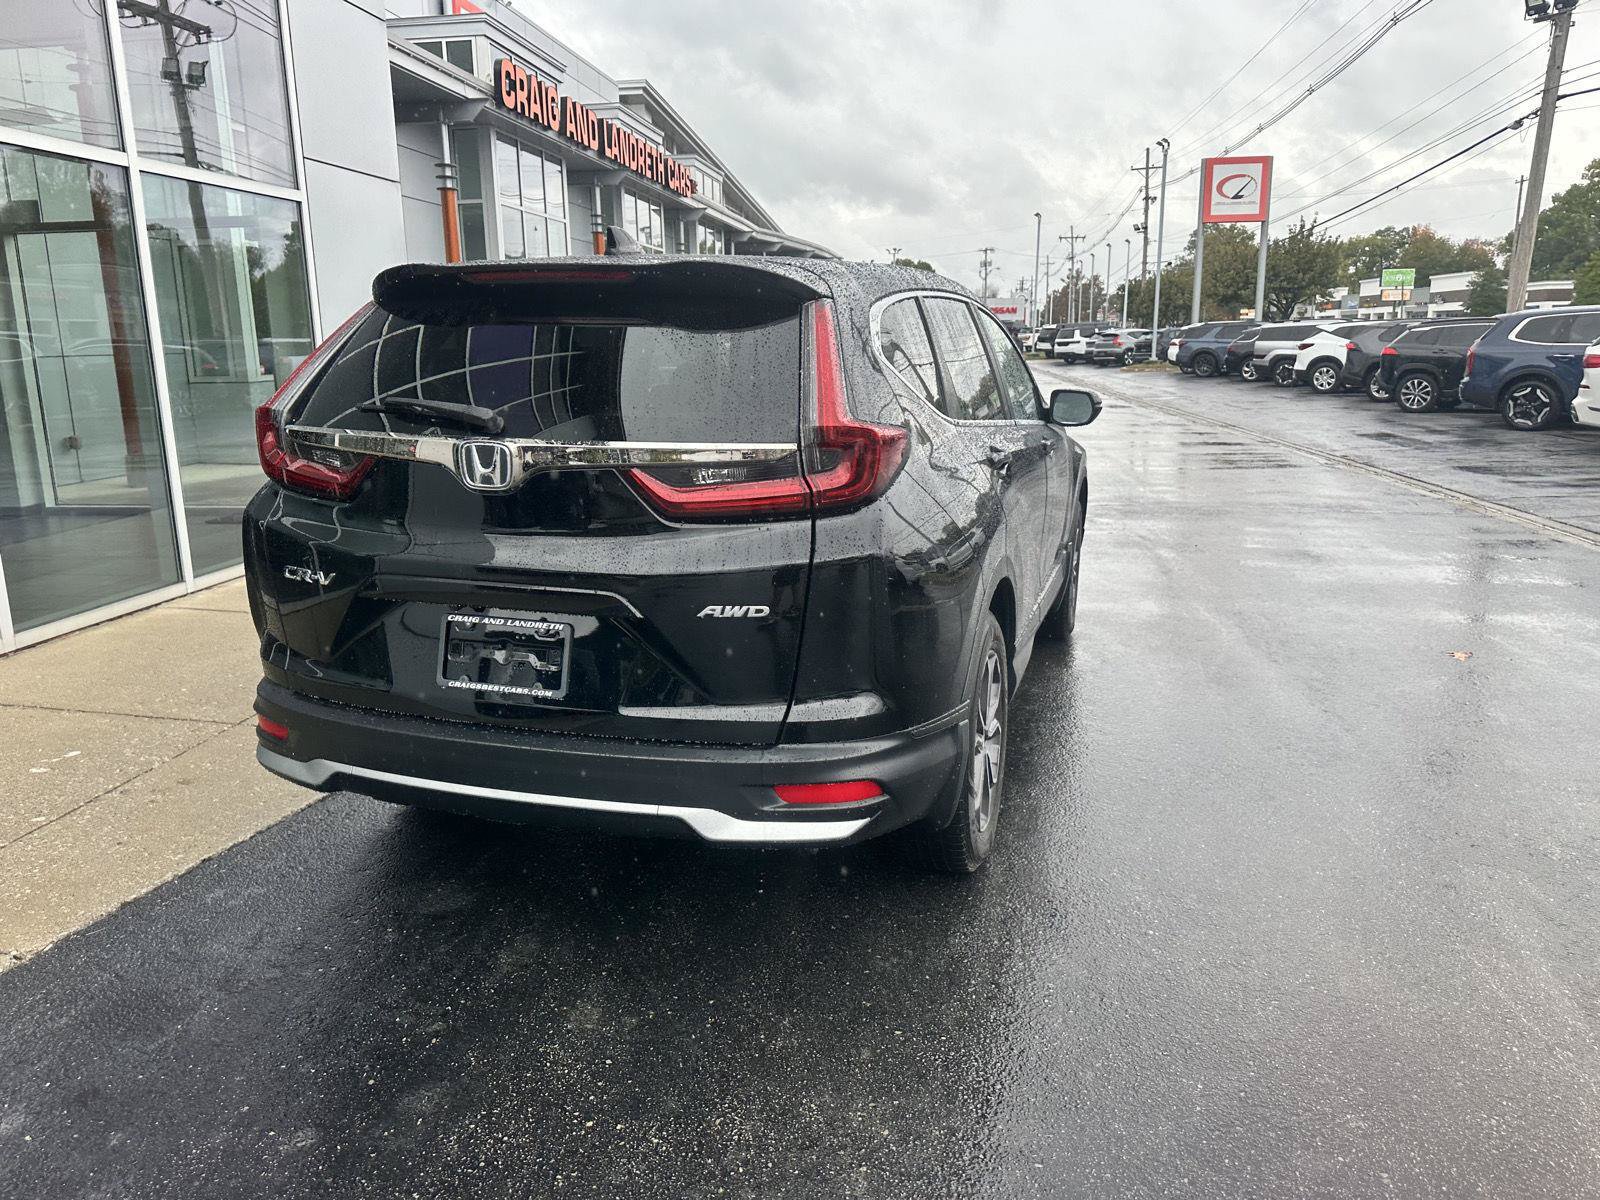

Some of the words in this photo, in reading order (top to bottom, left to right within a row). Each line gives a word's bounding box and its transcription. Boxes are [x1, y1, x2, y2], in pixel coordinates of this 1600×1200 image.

[500, 58, 560, 132] CRAIG
[566, 96, 600, 151] AND
[603, 118, 665, 185] LANDRETH
[667, 156, 692, 198] CARS
[283, 564, 336, 586] CR-V
[696, 605, 771, 619] AWD
[447, 614, 480, 624] CRAIG
[481, 617, 505, 626] AND
[506, 619, 565, 631] LANDRETH
[448, 680, 553, 698] CRAIGSBESTCARS.COM
